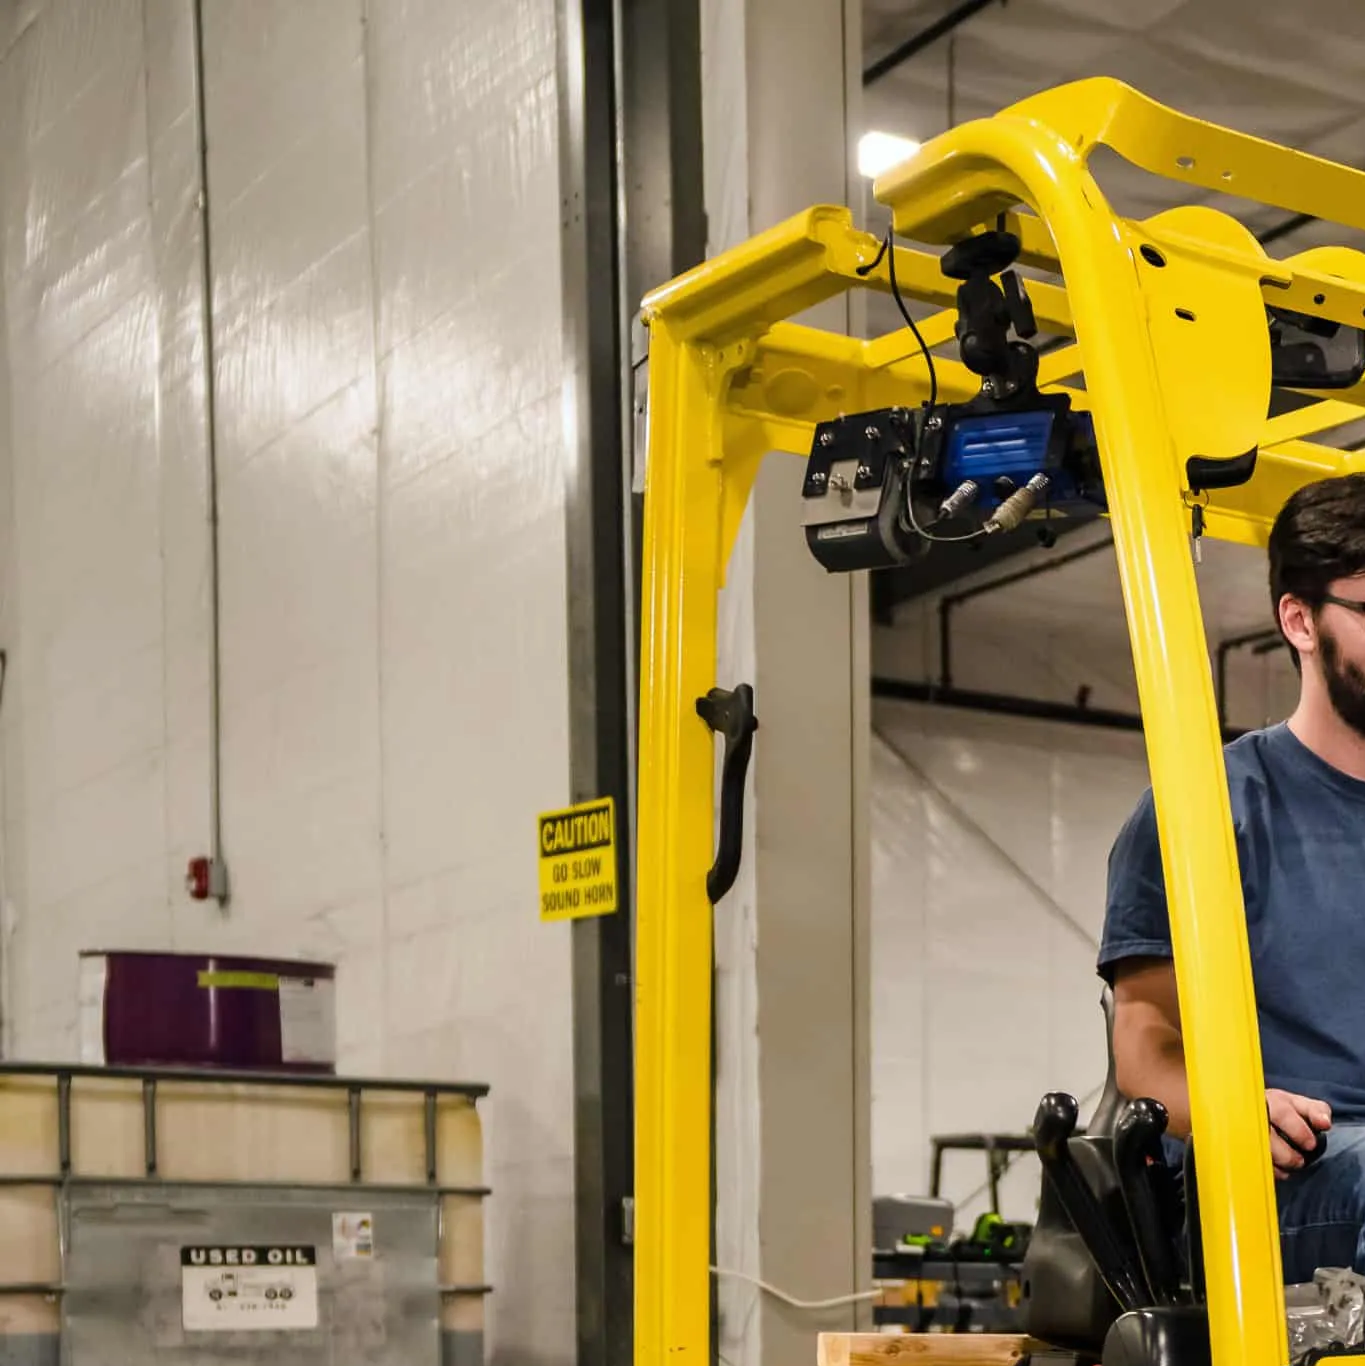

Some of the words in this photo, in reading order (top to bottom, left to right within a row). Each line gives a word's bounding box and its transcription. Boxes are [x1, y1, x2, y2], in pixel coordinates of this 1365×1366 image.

[542, 811, 609, 852] CAUTION
[553, 863, 567, 883] GO
[572, 859, 601, 880] SLOW
[542, 888, 579, 912] SOUND
[584, 883, 613, 905] HORN
[190, 1248, 256, 1264] USED
[267, 1248, 308, 1264] OIL
